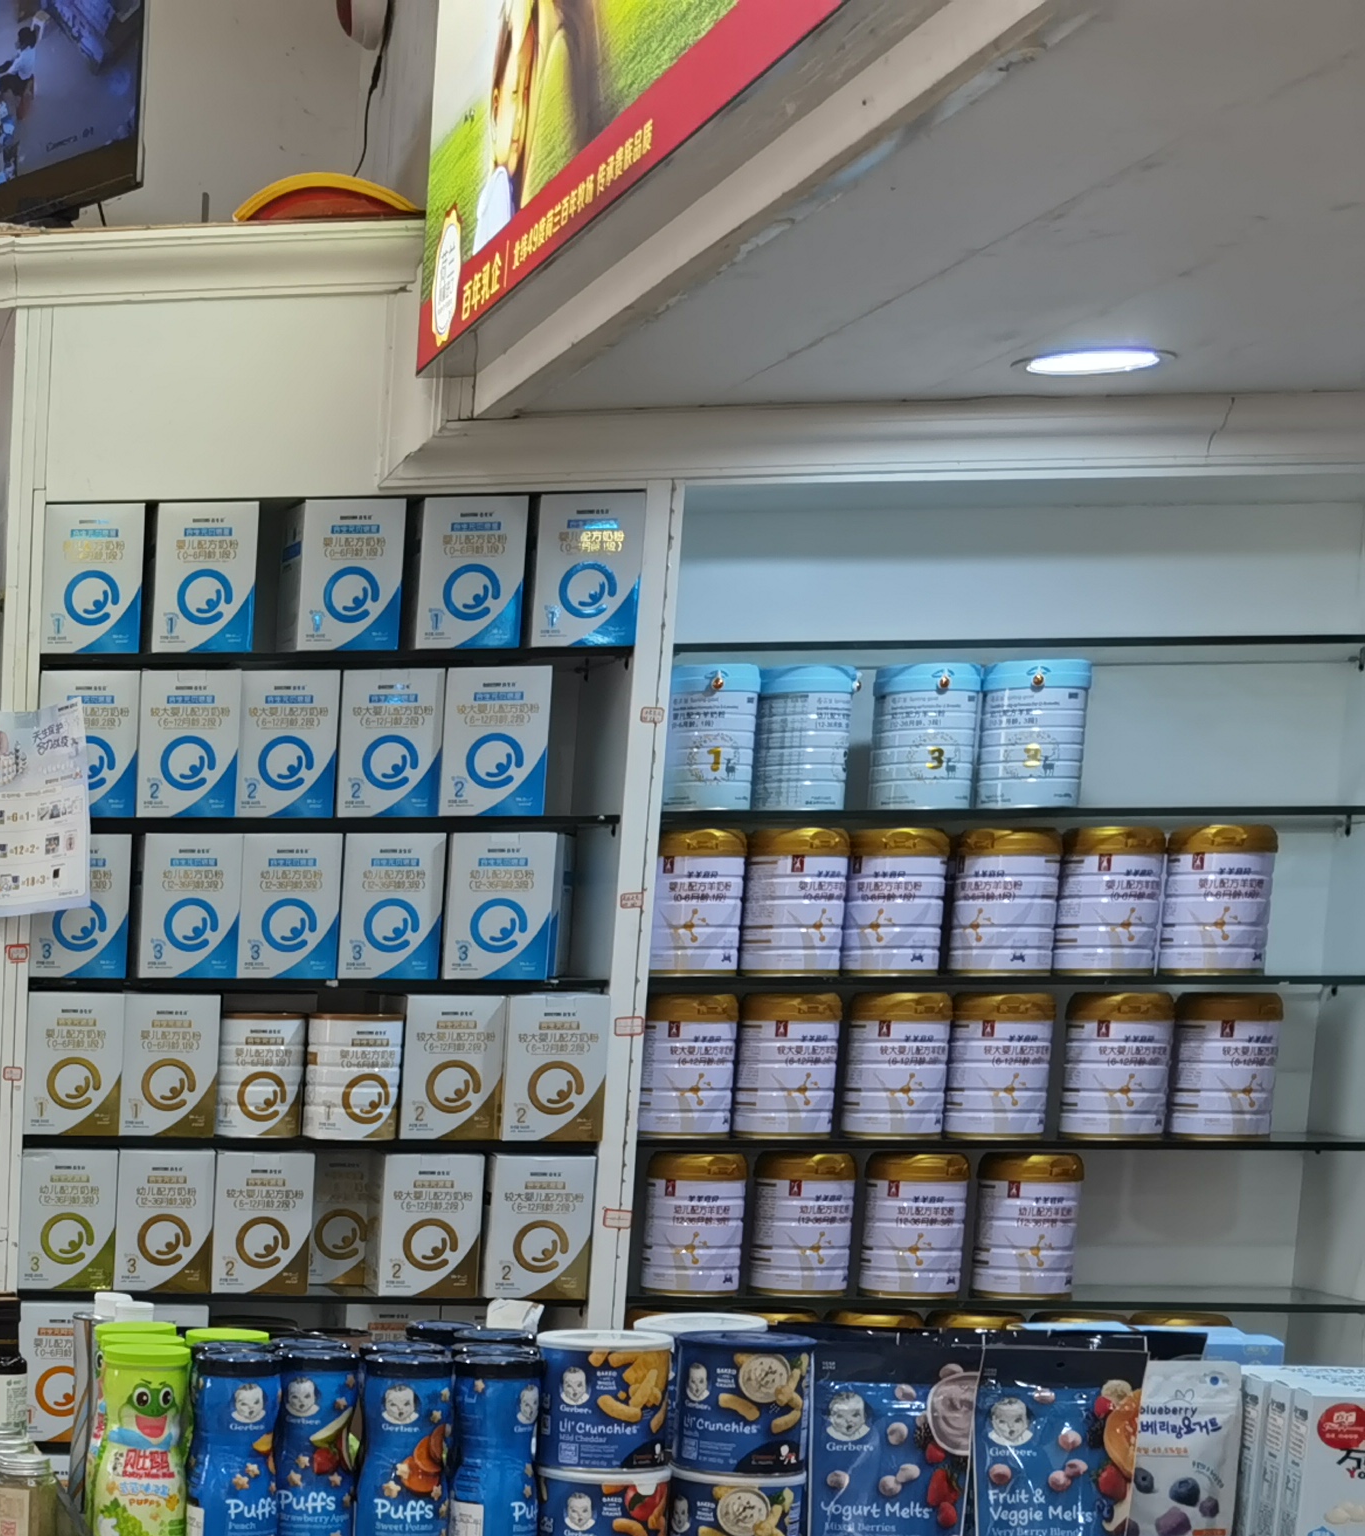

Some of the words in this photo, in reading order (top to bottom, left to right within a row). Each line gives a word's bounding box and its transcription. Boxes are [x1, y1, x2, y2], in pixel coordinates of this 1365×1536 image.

[461, 252, 502, 321] 百年乳企
[560, 1405, 591, 1413] Gerber
[381, 1423, 419, 1432] Gerber
[575, 1421, 638, 1435] Crunchies
[826, 1442, 872, 1452] Gerber
[277, 1489, 336, 1513] Puffs
[988, 1489, 1029, 1504] Fruit
[1032, 1489, 1045, 1503] &
[226, 1498, 277, 1520] Puffs
[374, 1499, 434, 1520] Puffs
[821, 1501, 881, 1521] Yogurt
[884, 1501, 930, 1519] Melts
[990, 1507, 1043, 1525] Veggie
[1048, 1506, 1093, 1523] Melts
[856, 1522, 896, 1532] Berries
[1045, 1526, 1078, 1536] Blend
